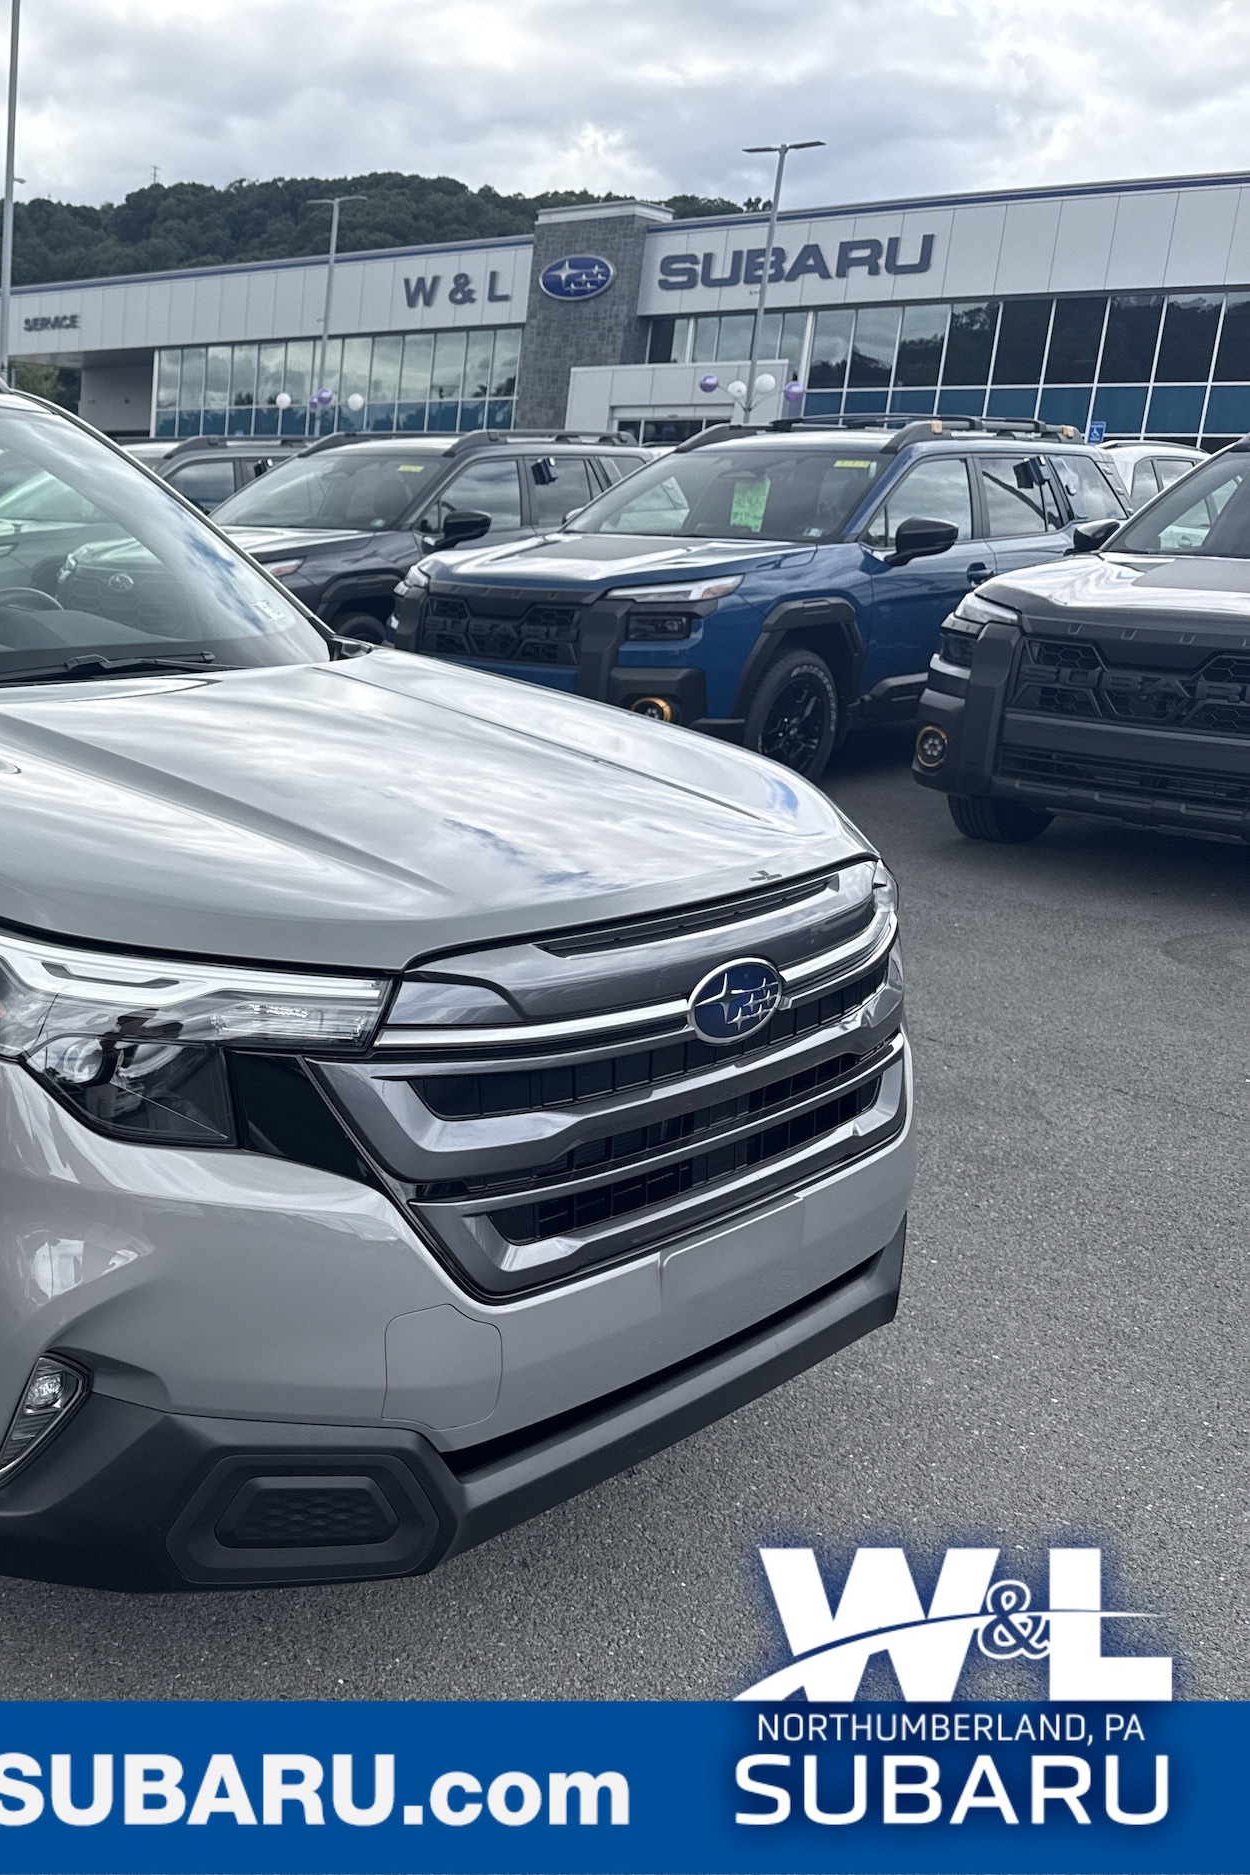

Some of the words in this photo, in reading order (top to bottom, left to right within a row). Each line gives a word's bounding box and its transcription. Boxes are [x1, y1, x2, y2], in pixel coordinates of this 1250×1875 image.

[658, 234, 934, 291] SUBARU
[403, 275, 441, 308] W
[448, 272, 476, 305] &
[487, 270, 512, 302] L
[23, 314, 79, 332] SERVICE
[423, 615, 581, 643] SUBARU
[1019, 663, 1250, 704] SUBAR
